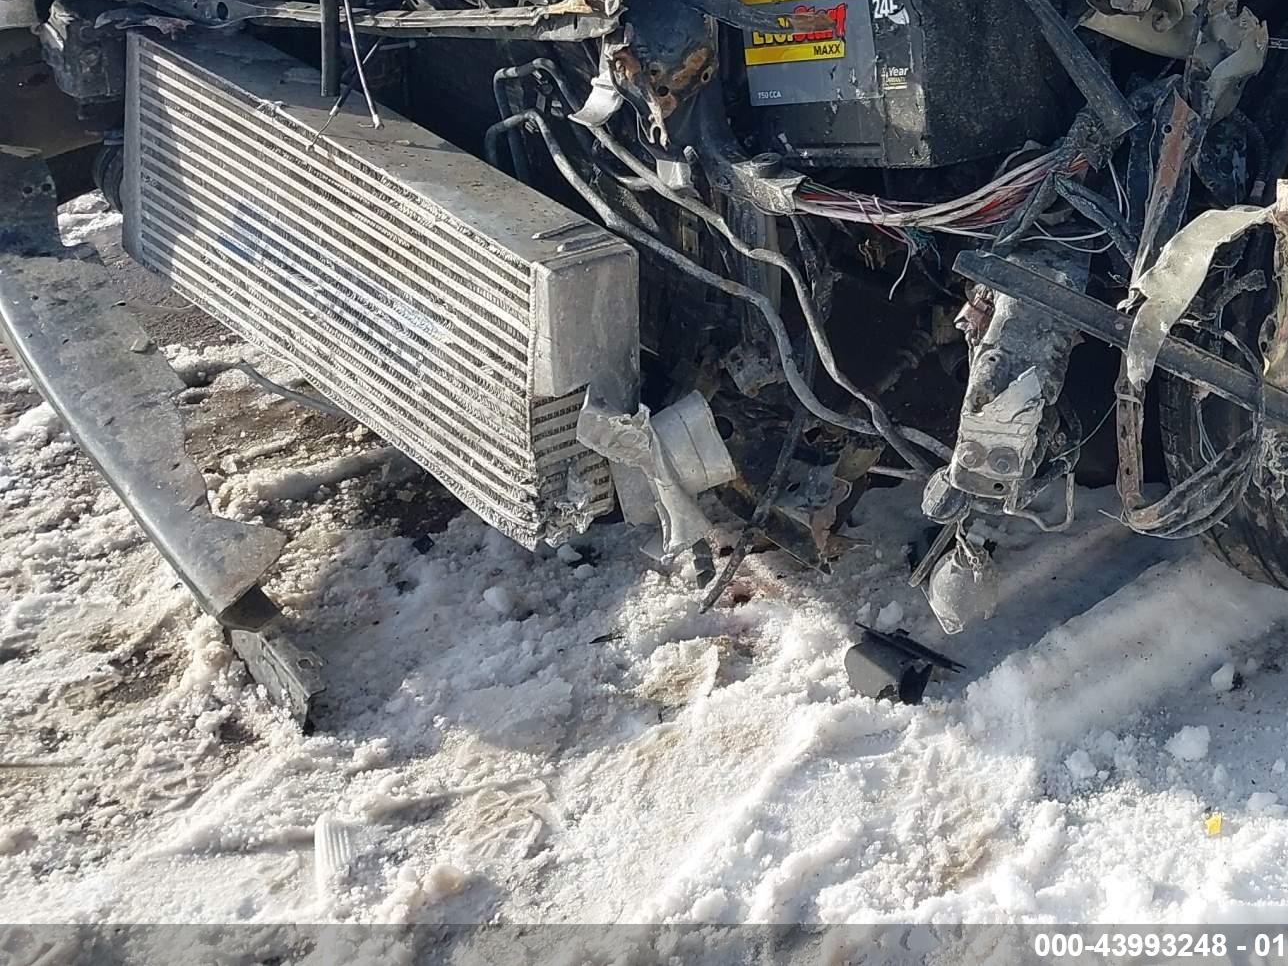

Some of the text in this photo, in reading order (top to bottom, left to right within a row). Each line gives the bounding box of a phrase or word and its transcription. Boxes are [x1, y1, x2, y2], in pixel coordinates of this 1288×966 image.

[813, 43, 841, 56] MAXX
[888, 66, 909, 77] Year
[769, 90, 782, 99] CCA
